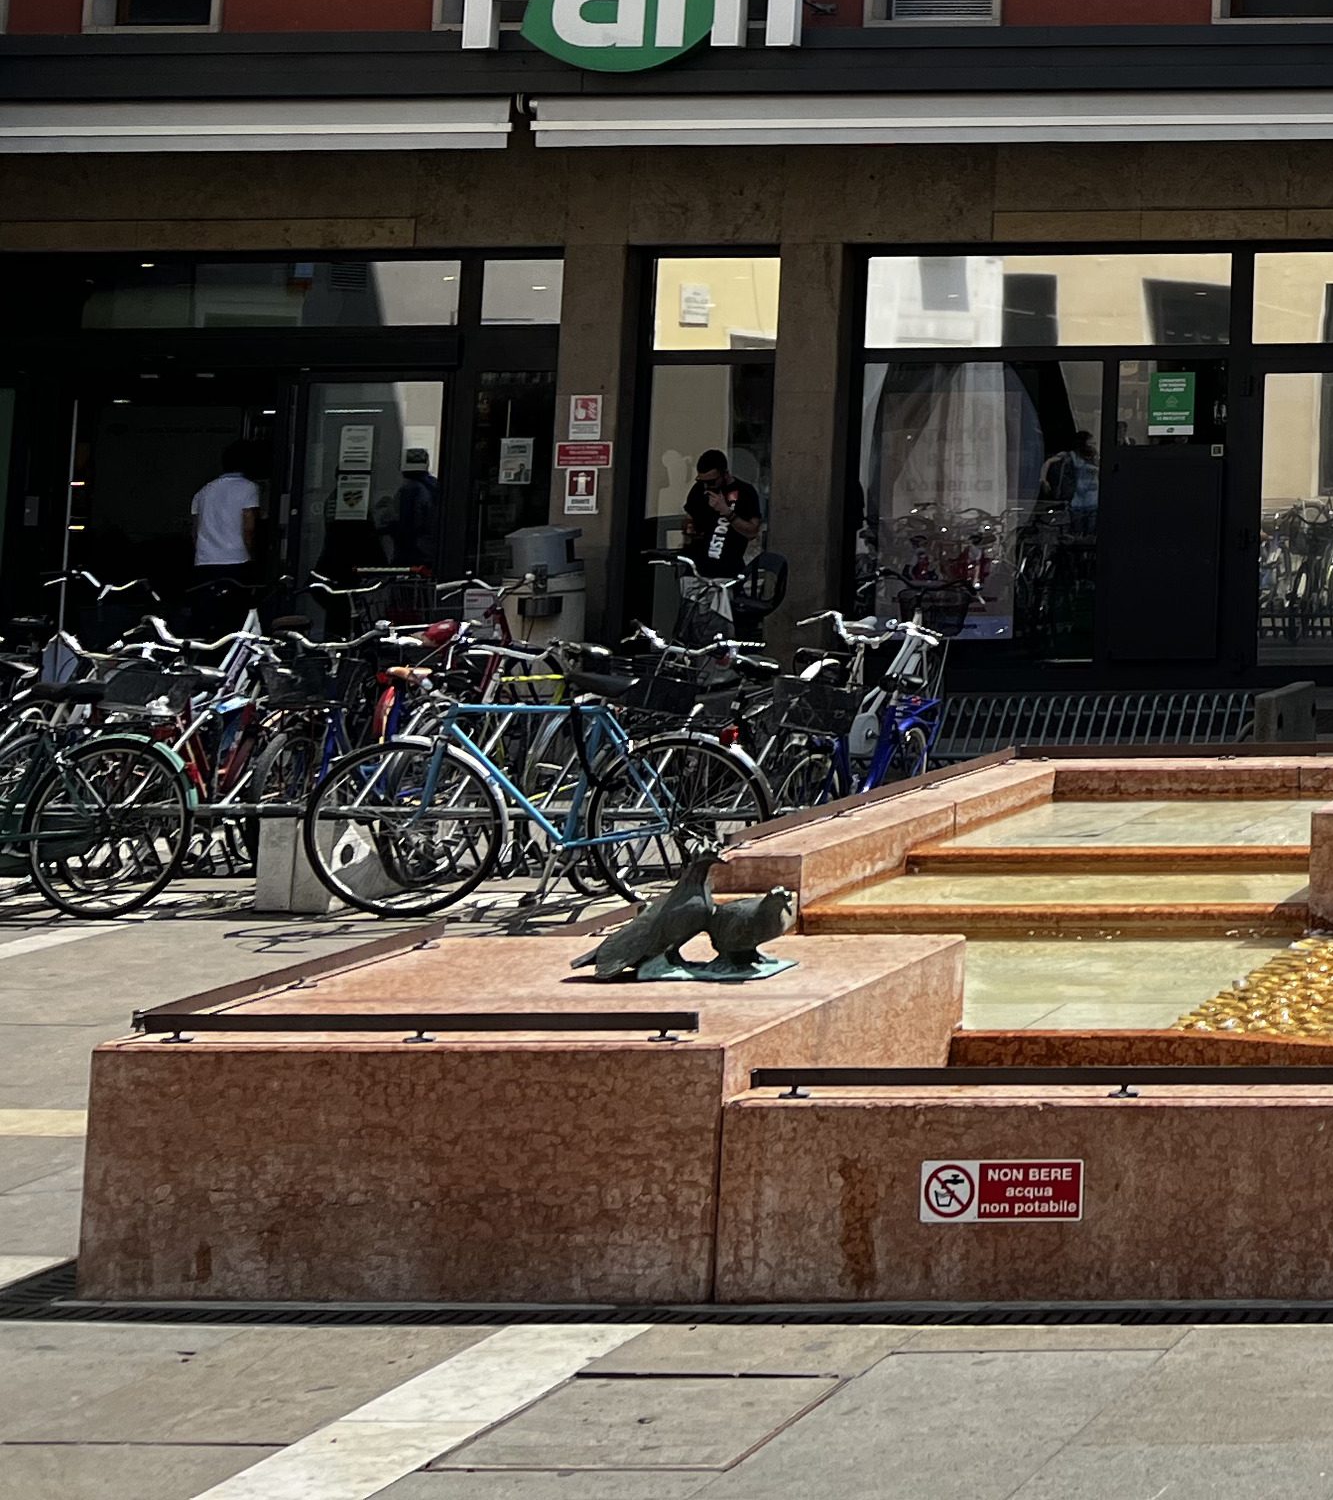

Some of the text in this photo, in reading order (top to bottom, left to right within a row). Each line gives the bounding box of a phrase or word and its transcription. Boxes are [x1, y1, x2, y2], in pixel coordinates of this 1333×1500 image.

[987, 1167, 1072, 1181] NON BERE
[1005, 1186, 1053, 1199] acqua
[980, 1199, 1077, 1215] non potabile
